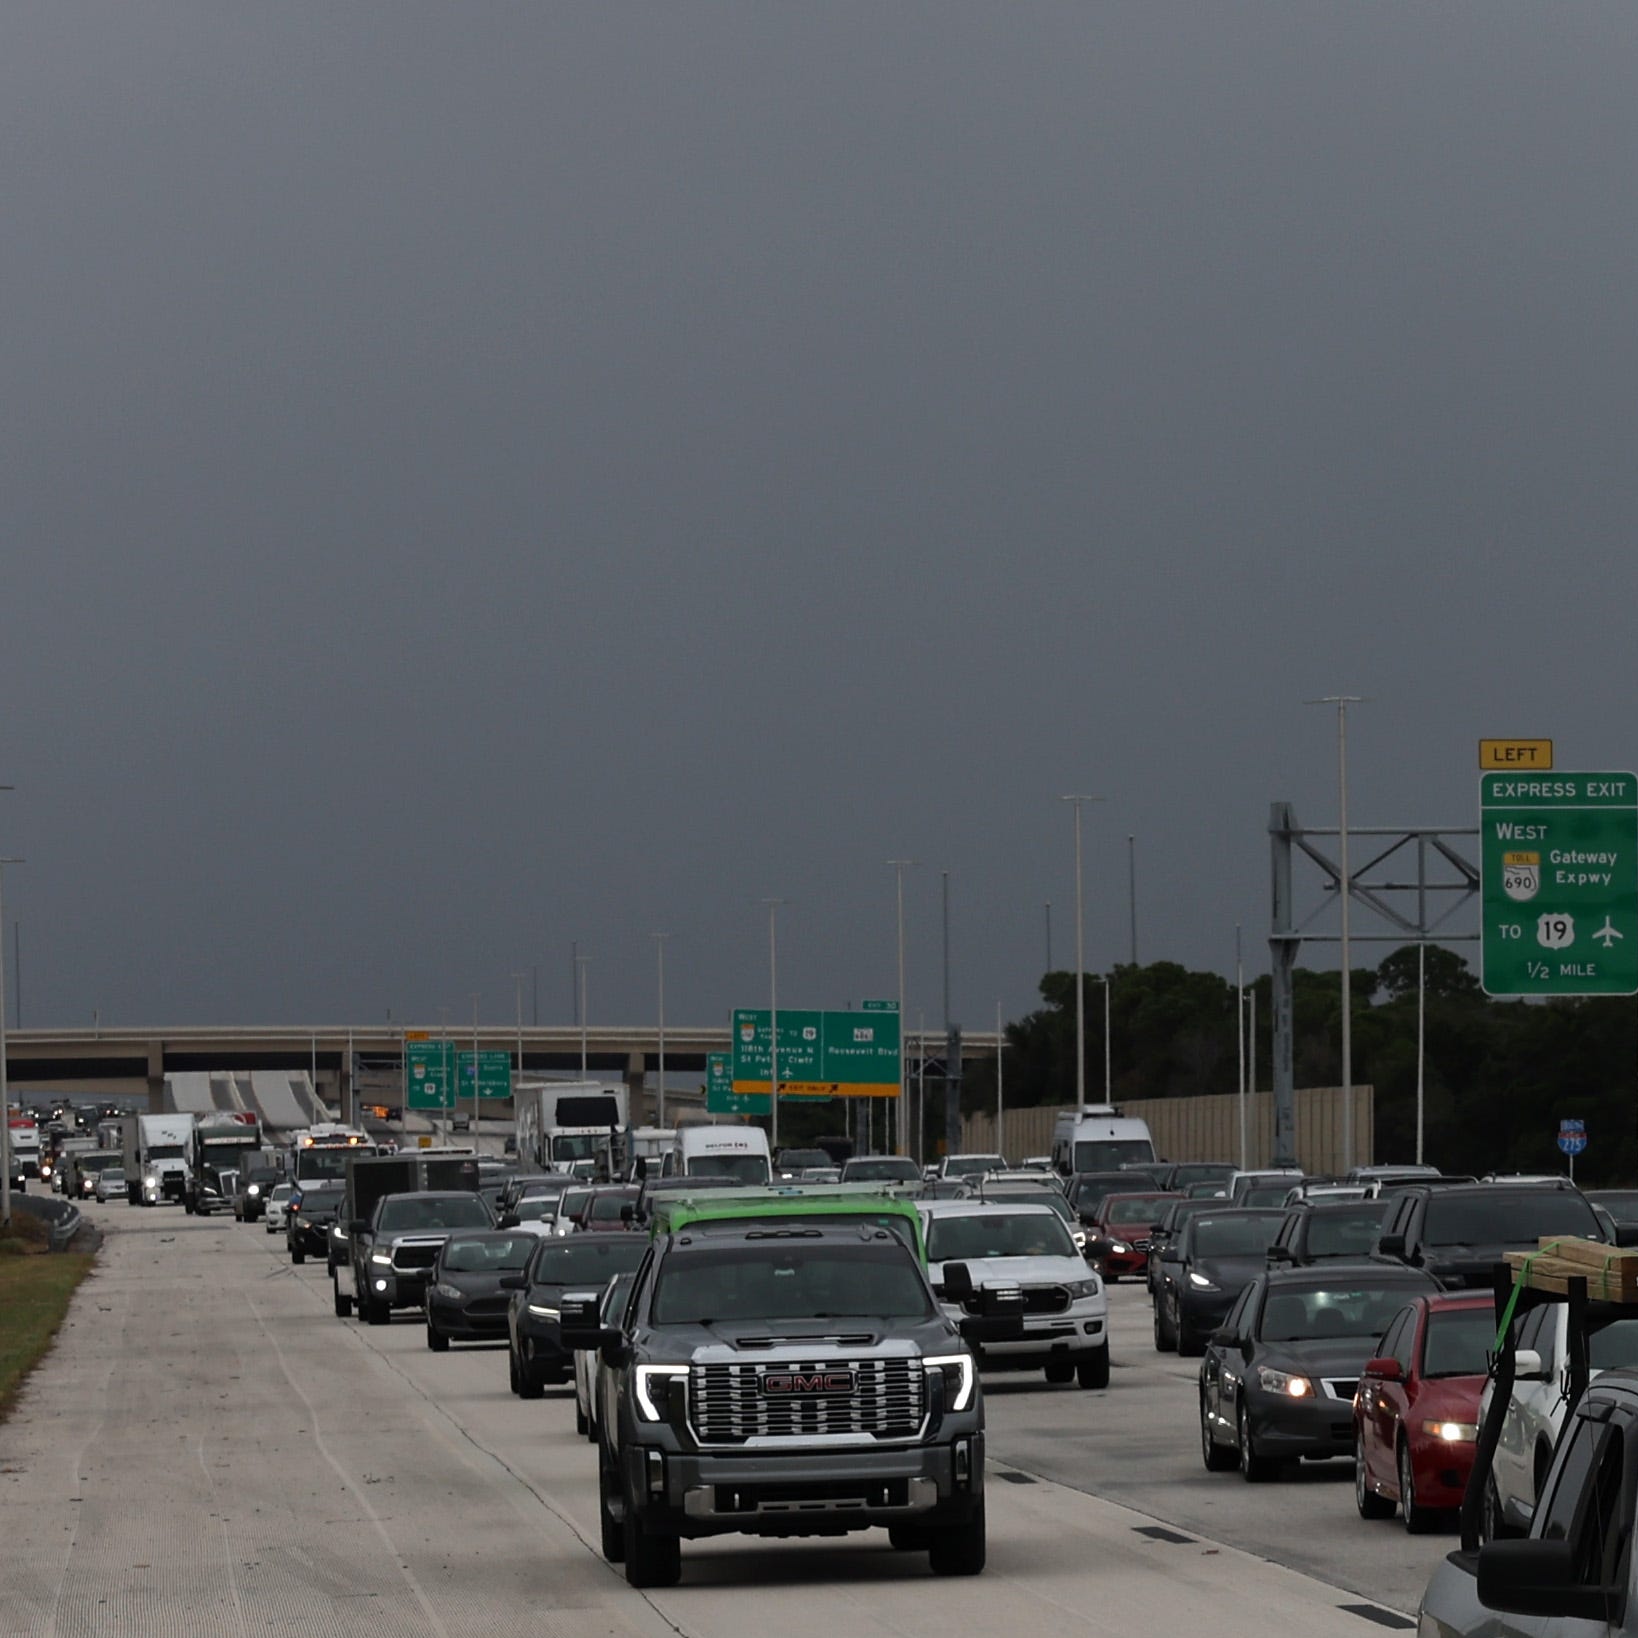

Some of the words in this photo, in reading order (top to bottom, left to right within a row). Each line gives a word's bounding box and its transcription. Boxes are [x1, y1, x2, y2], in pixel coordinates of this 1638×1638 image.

[1493, 748, 1538, 761] LEFT
[1492, 783, 1576, 797] EXPRESS
[1586, 782, 1626, 796] EXIT
[1496, 822, 1548, 840] WEST
[1511, 853, 1530, 862] TOLL
[1550, 850, 1618, 867] Gateway
[1505, 877, 1532, 889] 690
[1555, 870, 1612, 886] Expwy
[1498, 924, 1522, 939] TO
[1543, 920, 1568, 941] 19
[1559, 963, 1596, 977] MILE
[766, 1373, 851, 1393] GMC
